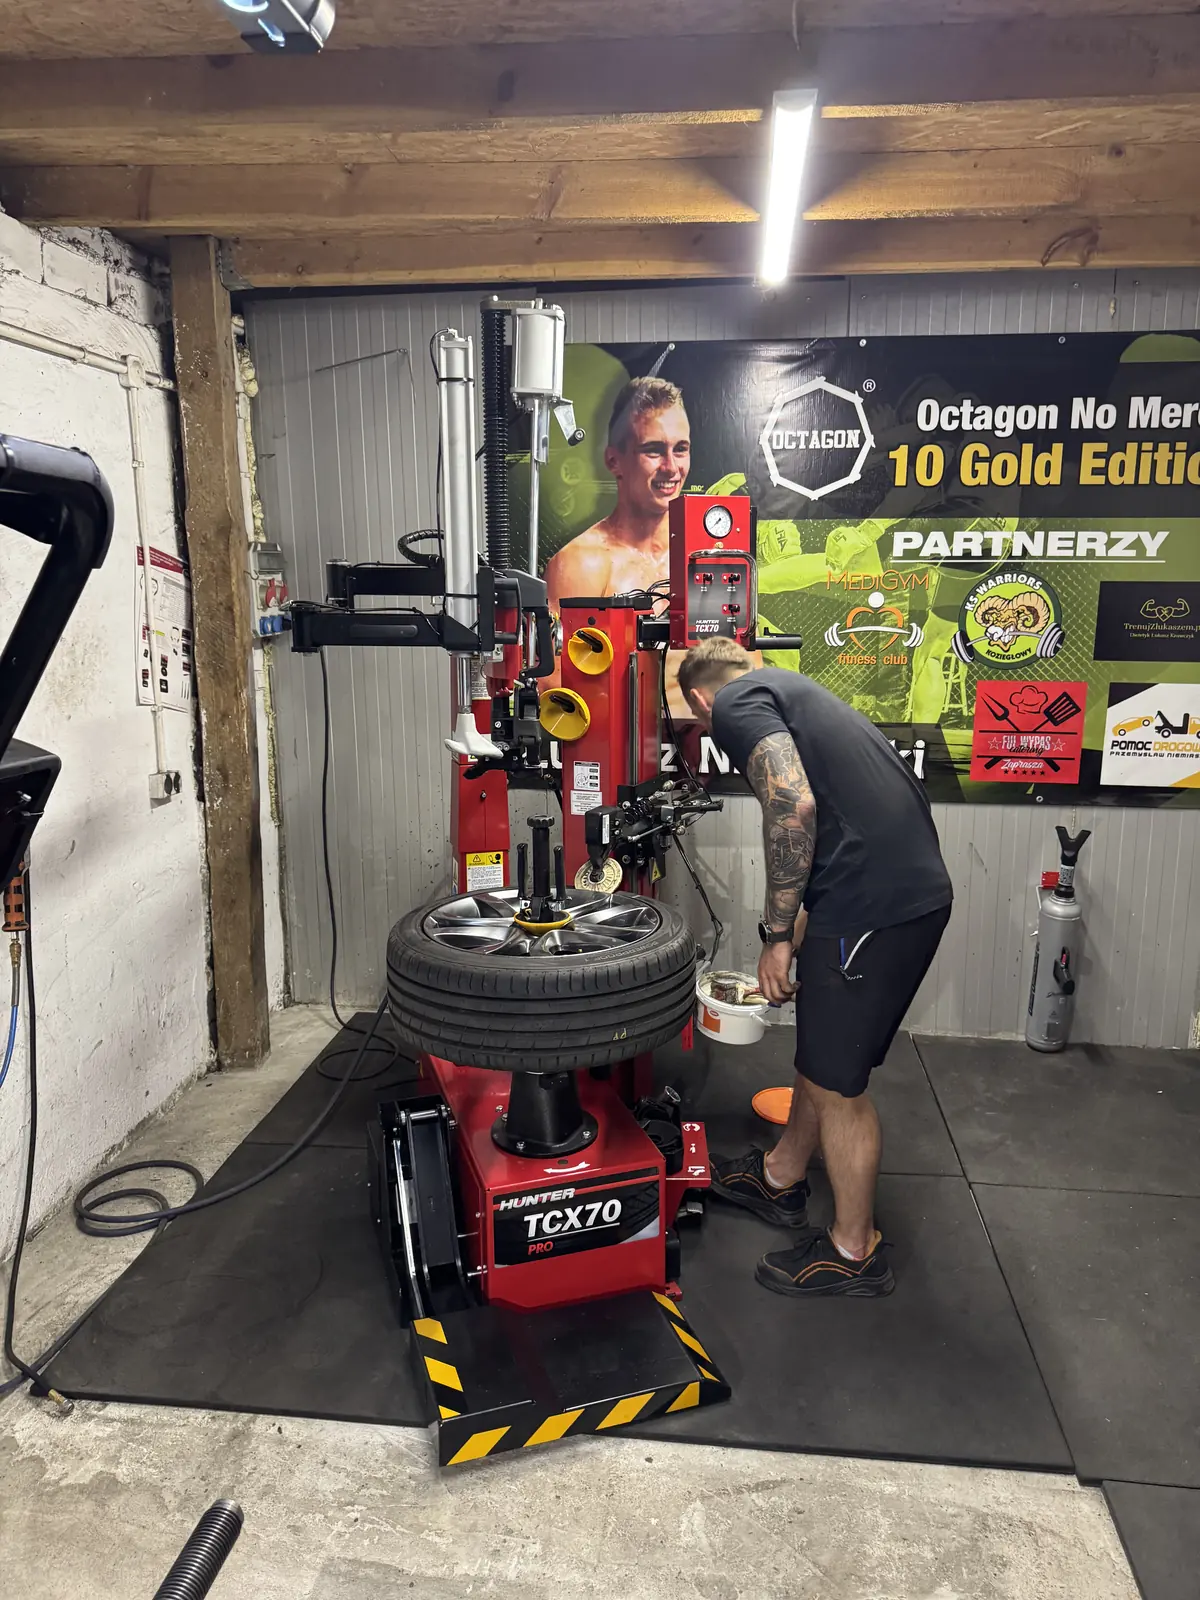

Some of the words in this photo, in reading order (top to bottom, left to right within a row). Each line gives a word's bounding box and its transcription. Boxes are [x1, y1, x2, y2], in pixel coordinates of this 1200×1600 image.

[917, 398, 1059, 438] Octagon
[1070, 396, 1117, 430] No
[1128, 396, 1200, 429] Mer
[772, 429, 861, 450] OCTAGON
[888, 443, 945, 487] 10
[960, 442, 1064, 486] Gold
[892, 530, 1170, 558] PARTNERZY
[965, 595, 978, 612] KS
[976, 573, 1043, 596] WARRIORS
[695, 624, 720, 633] TCX70
[838, 652, 877, 665] fitness
[883, 653, 908, 665] club
[1020, 735, 1051, 751] WYPAS
[1110, 740, 1152, 751] POMOC
[1001, 759, 1044, 771] Zaprasza
[499, 1187, 576, 1212] HUNTER
[523, 1199, 622, 1238] TCX70
[527, 1241, 554, 1255] PRO
